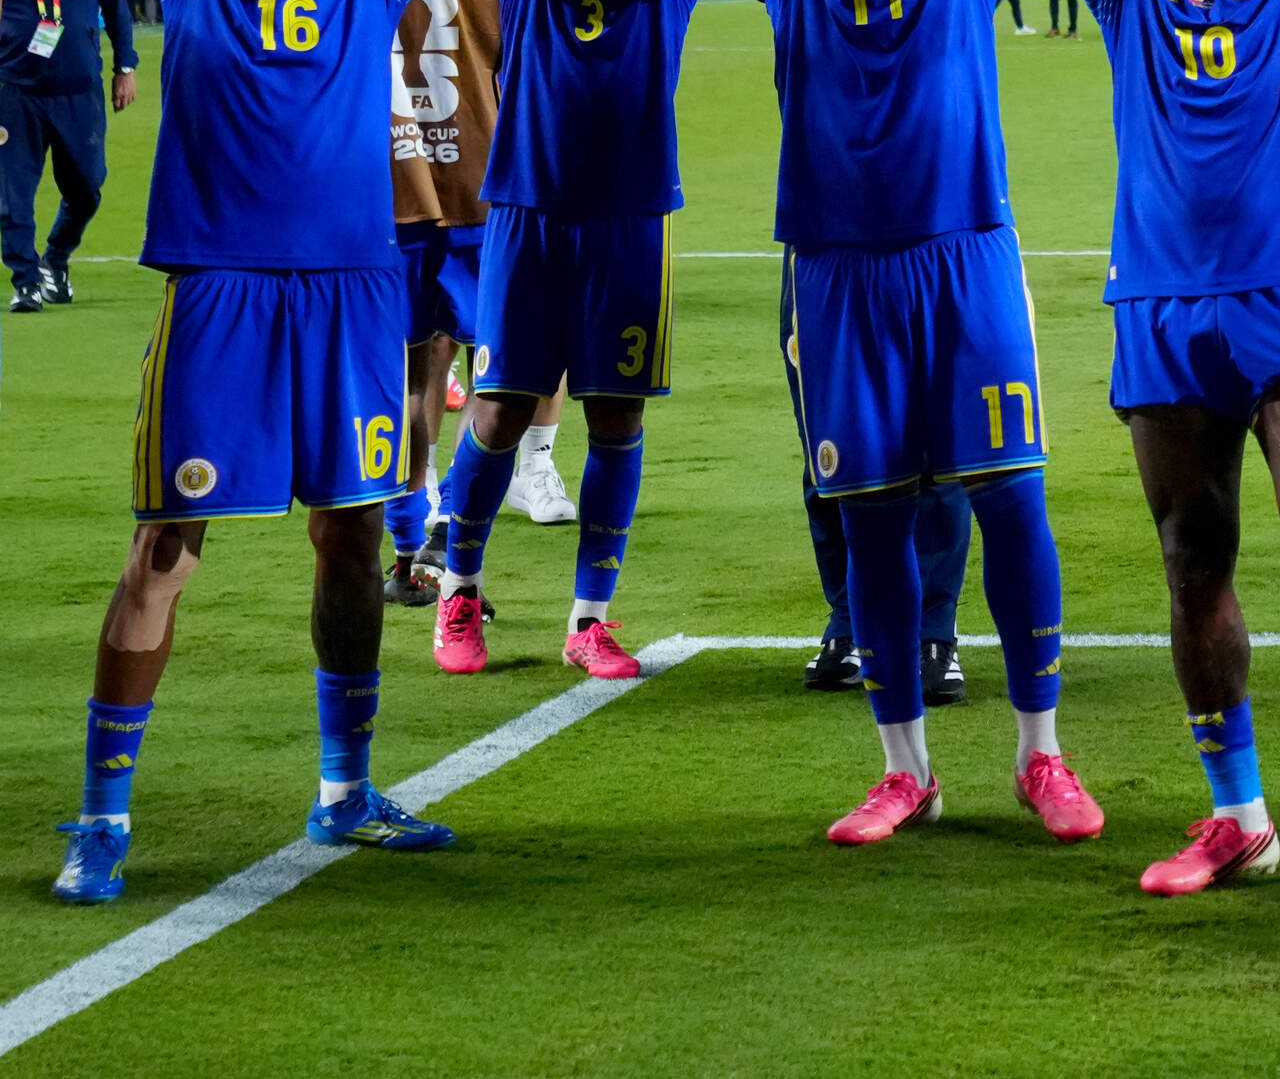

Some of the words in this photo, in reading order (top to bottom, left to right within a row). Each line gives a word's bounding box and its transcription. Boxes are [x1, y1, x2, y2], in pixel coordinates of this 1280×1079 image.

[1175, 25, 1237, 81] 10
[411, 95, 434, 109] FA
[426, 128, 460, 142] CUP
[617, 325, 647, 377] 3
[981, 382, 1035, 449] 17
[354, 415, 394, 482] 16
